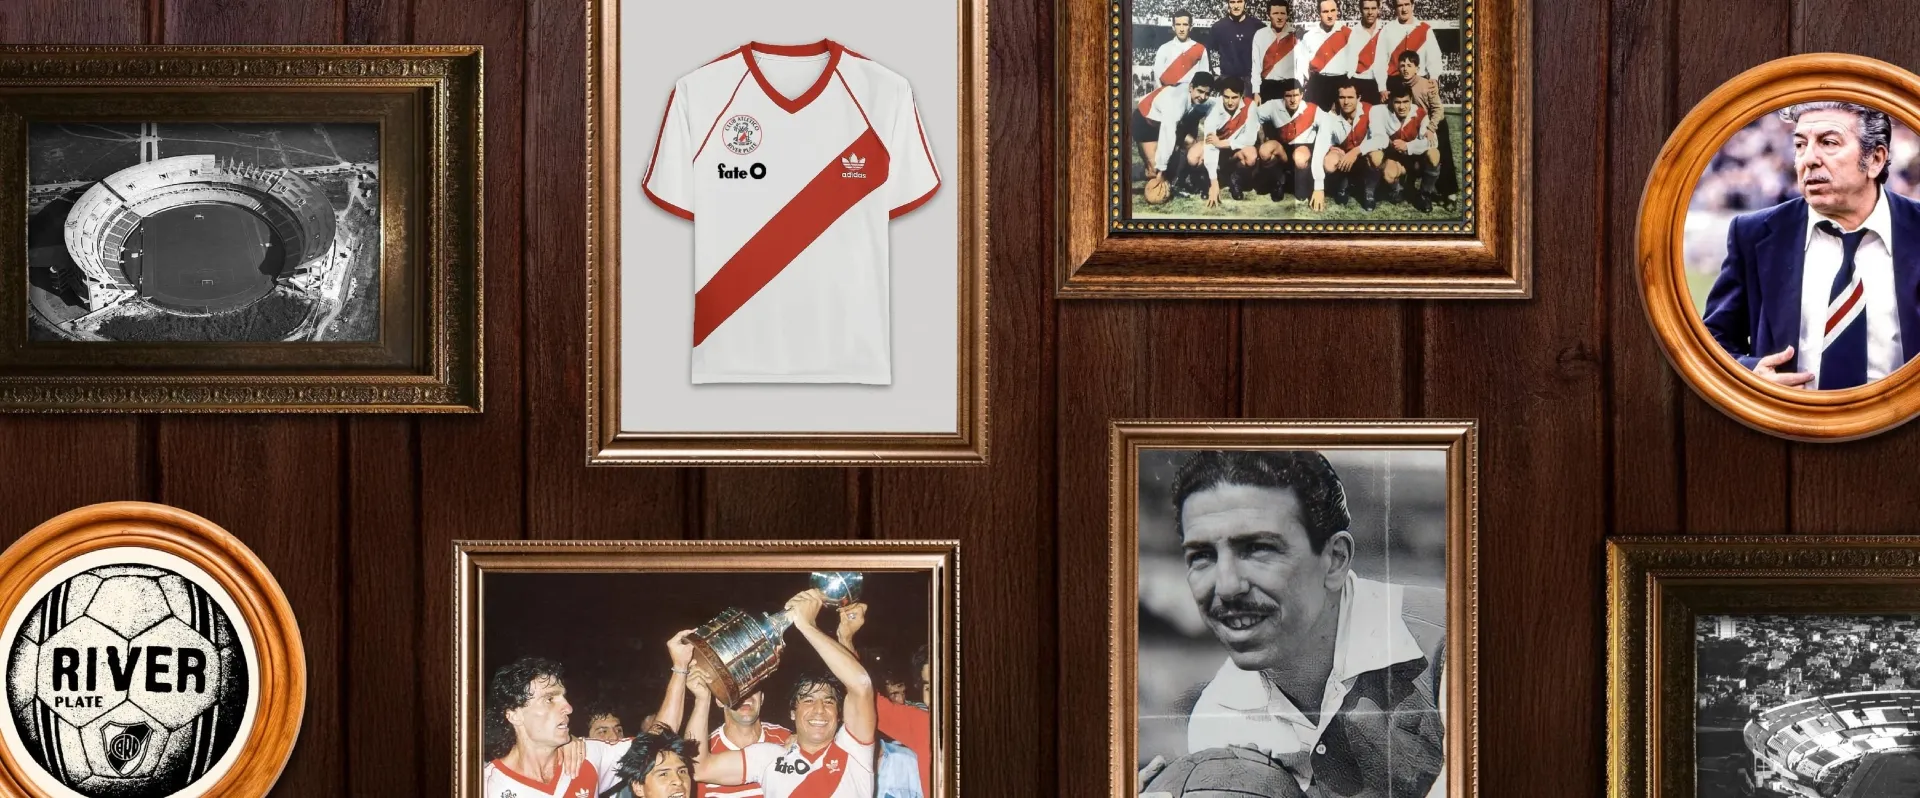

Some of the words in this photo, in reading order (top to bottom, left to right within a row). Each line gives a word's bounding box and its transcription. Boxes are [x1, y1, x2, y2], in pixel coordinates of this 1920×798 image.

[725, 118, 737, 131] CLUB
[727, 142, 742, 153] RIVER
[743, 142, 757, 153] PLATE
[841, 171, 867, 179] adidas
[52, 645, 207, 694] RIVER
[54, 695, 104, 708] PLATE
